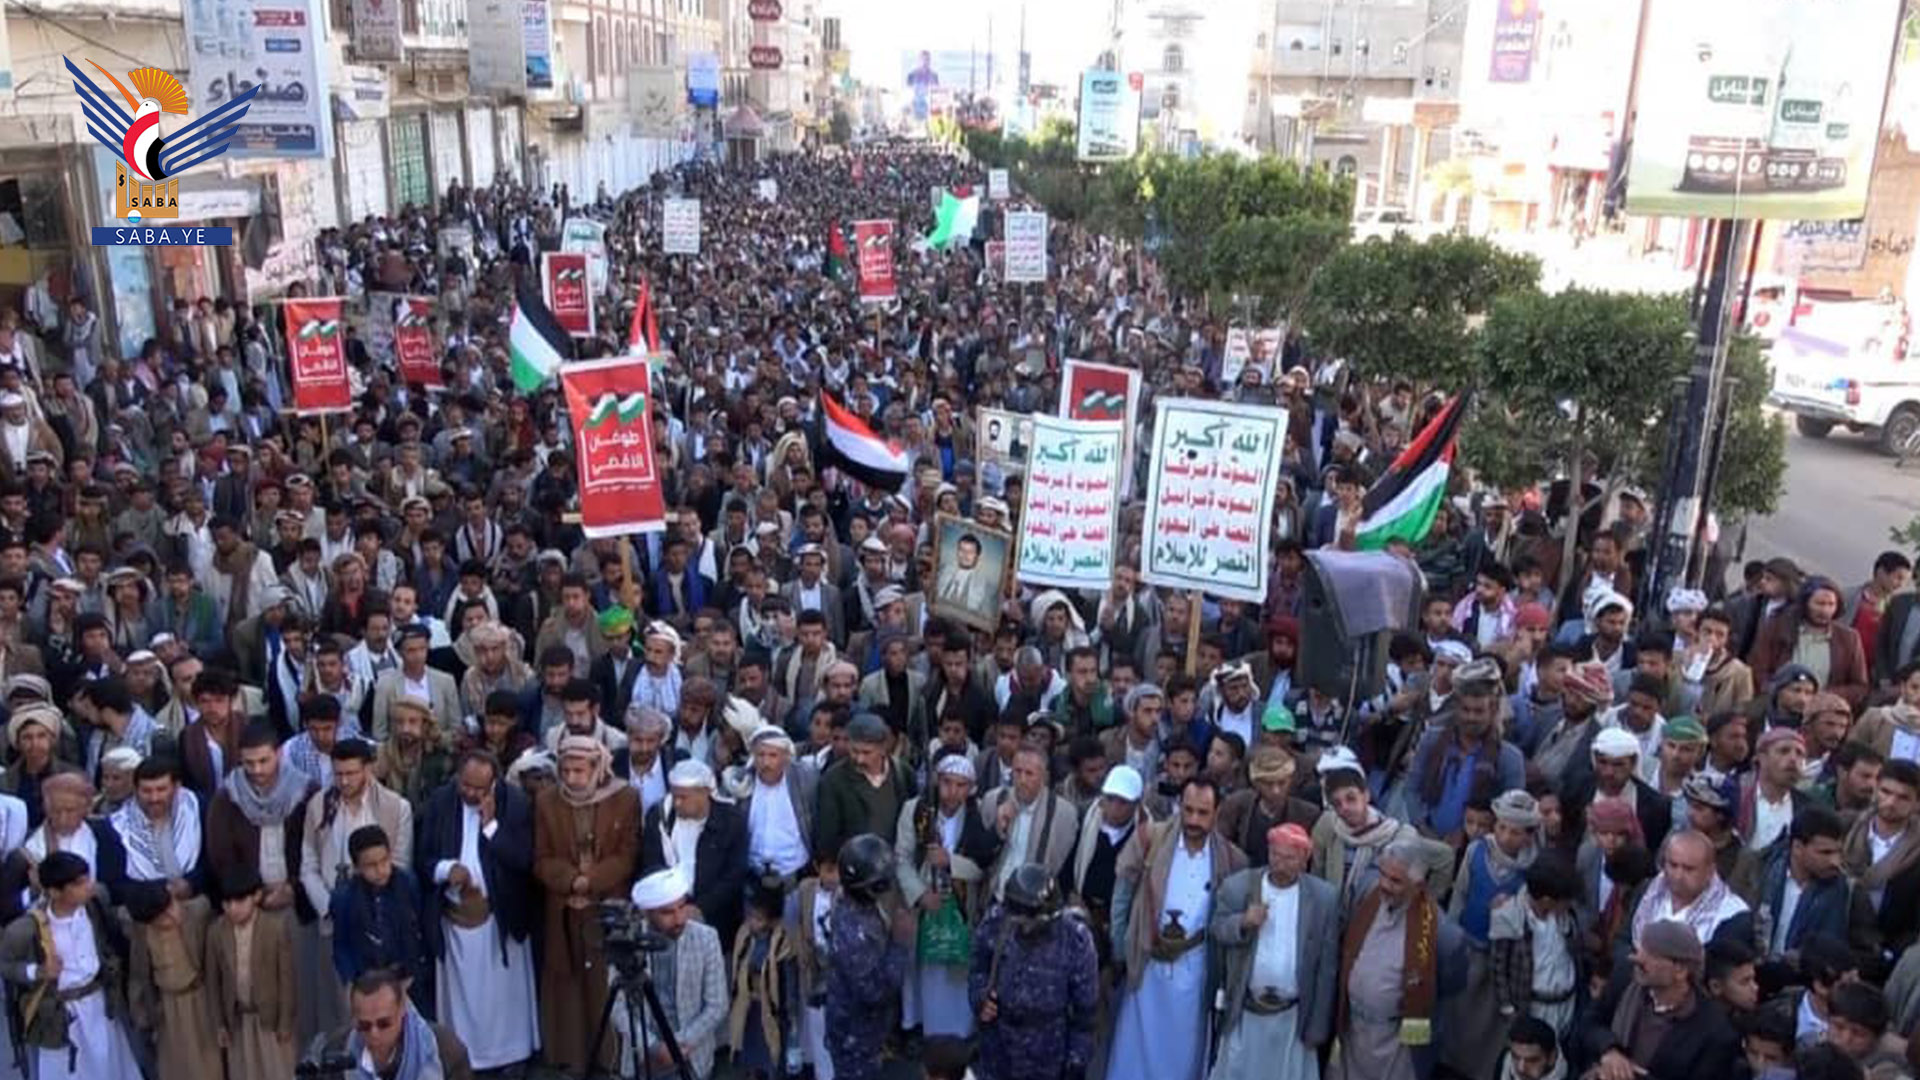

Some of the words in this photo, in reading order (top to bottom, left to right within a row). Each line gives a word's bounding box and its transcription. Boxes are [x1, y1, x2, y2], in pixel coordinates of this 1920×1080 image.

[588, 430, 640, 453] طوفان
[1168, 418, 1230, 454] أكبر
[1232, 424, 1270, 454] الله
[1084, 440, 1116, 463] الله
[1076, 476, 1113, 493] الموت
[1221, 462, 1264, 486] الموت
[1074, 501, 1111, 518] الموت
[1217, 494, 1259, 515] الموت
[1158, 516, 1196, 537] اليهود
[1070, 548, 1109, 572] النصر
[1211, 549, 1256, 576] النصر
